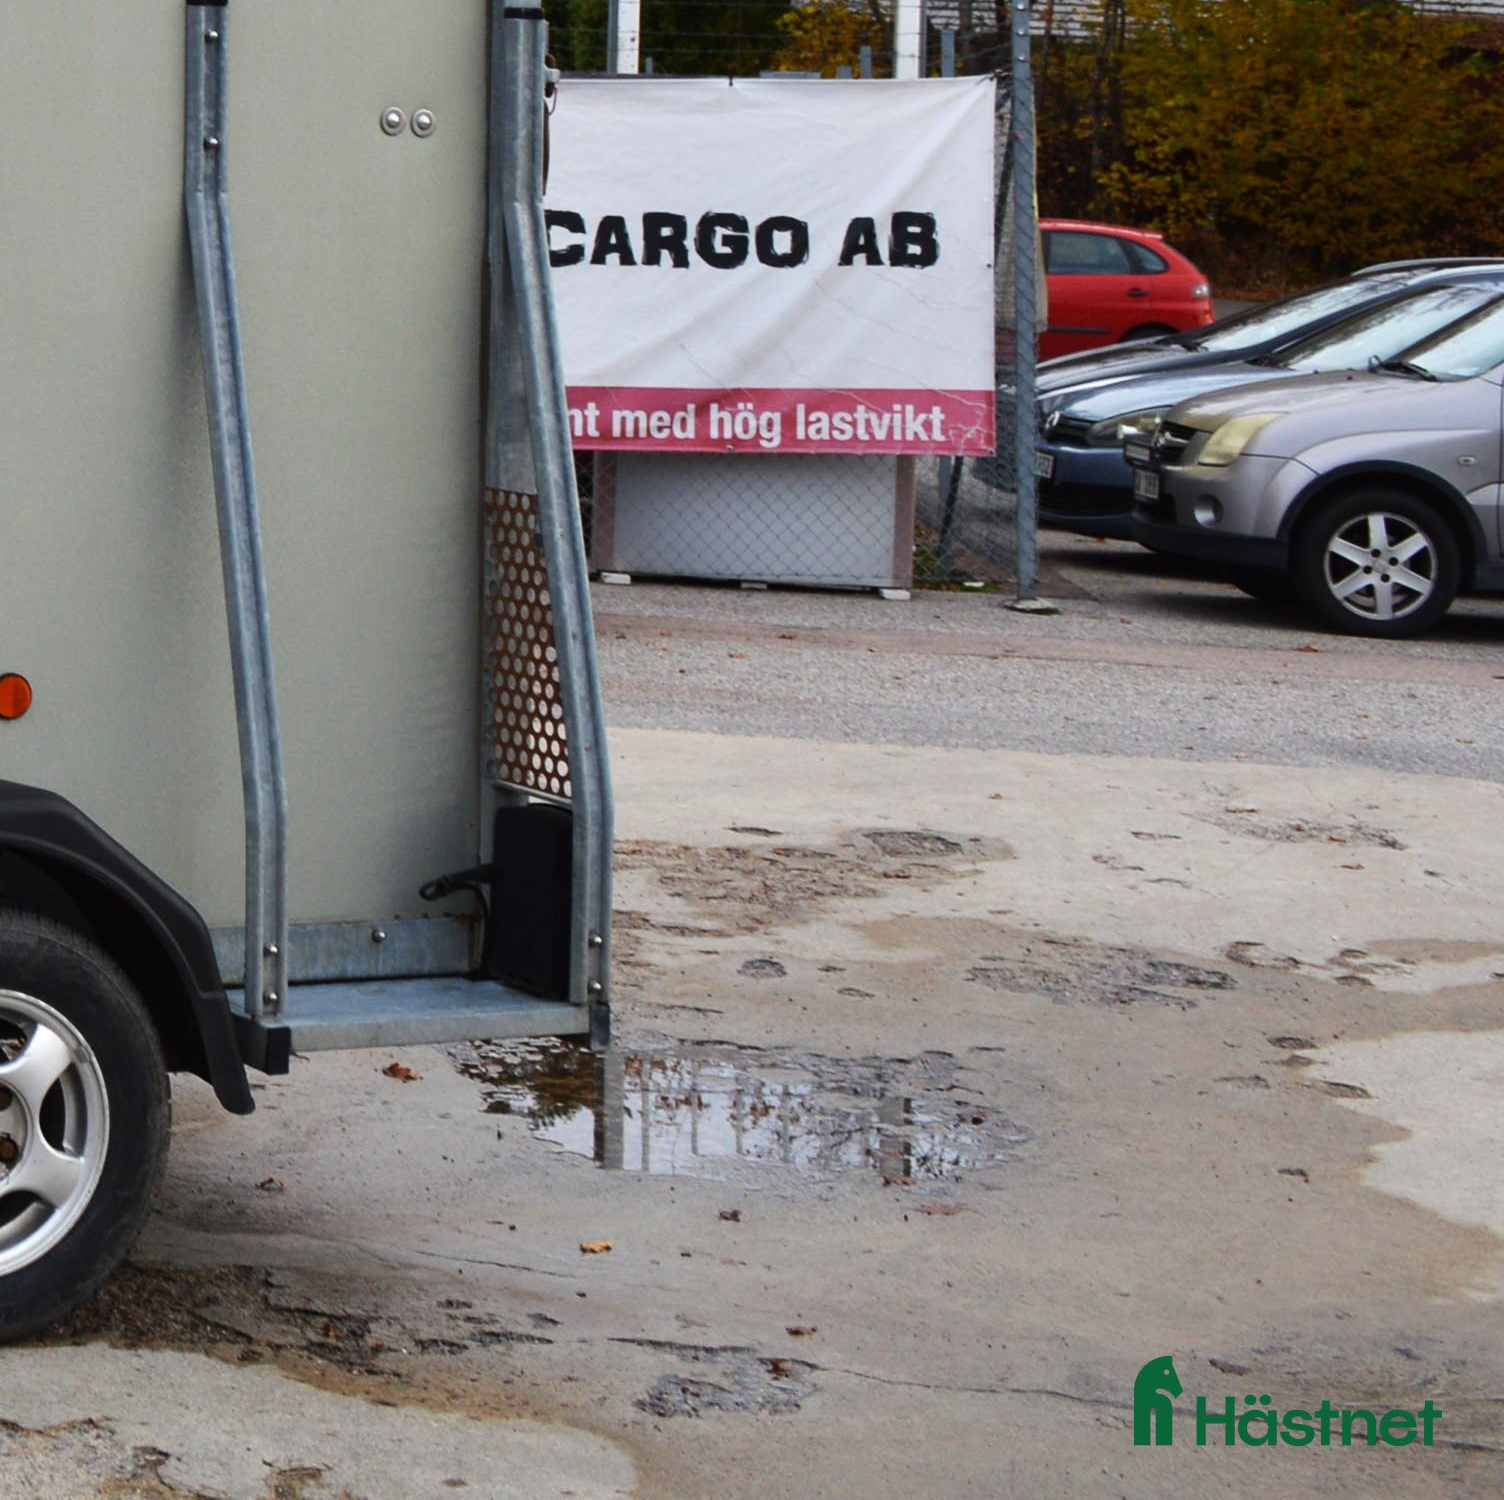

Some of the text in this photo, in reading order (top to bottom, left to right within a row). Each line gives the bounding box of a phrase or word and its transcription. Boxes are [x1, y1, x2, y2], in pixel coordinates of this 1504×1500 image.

[544, 209, 941, 270] CARGO AB
[612, 403, 696, 440] med
[709, 402, 782, 447] hög
[796, 403, 946, 442] lastvikt
